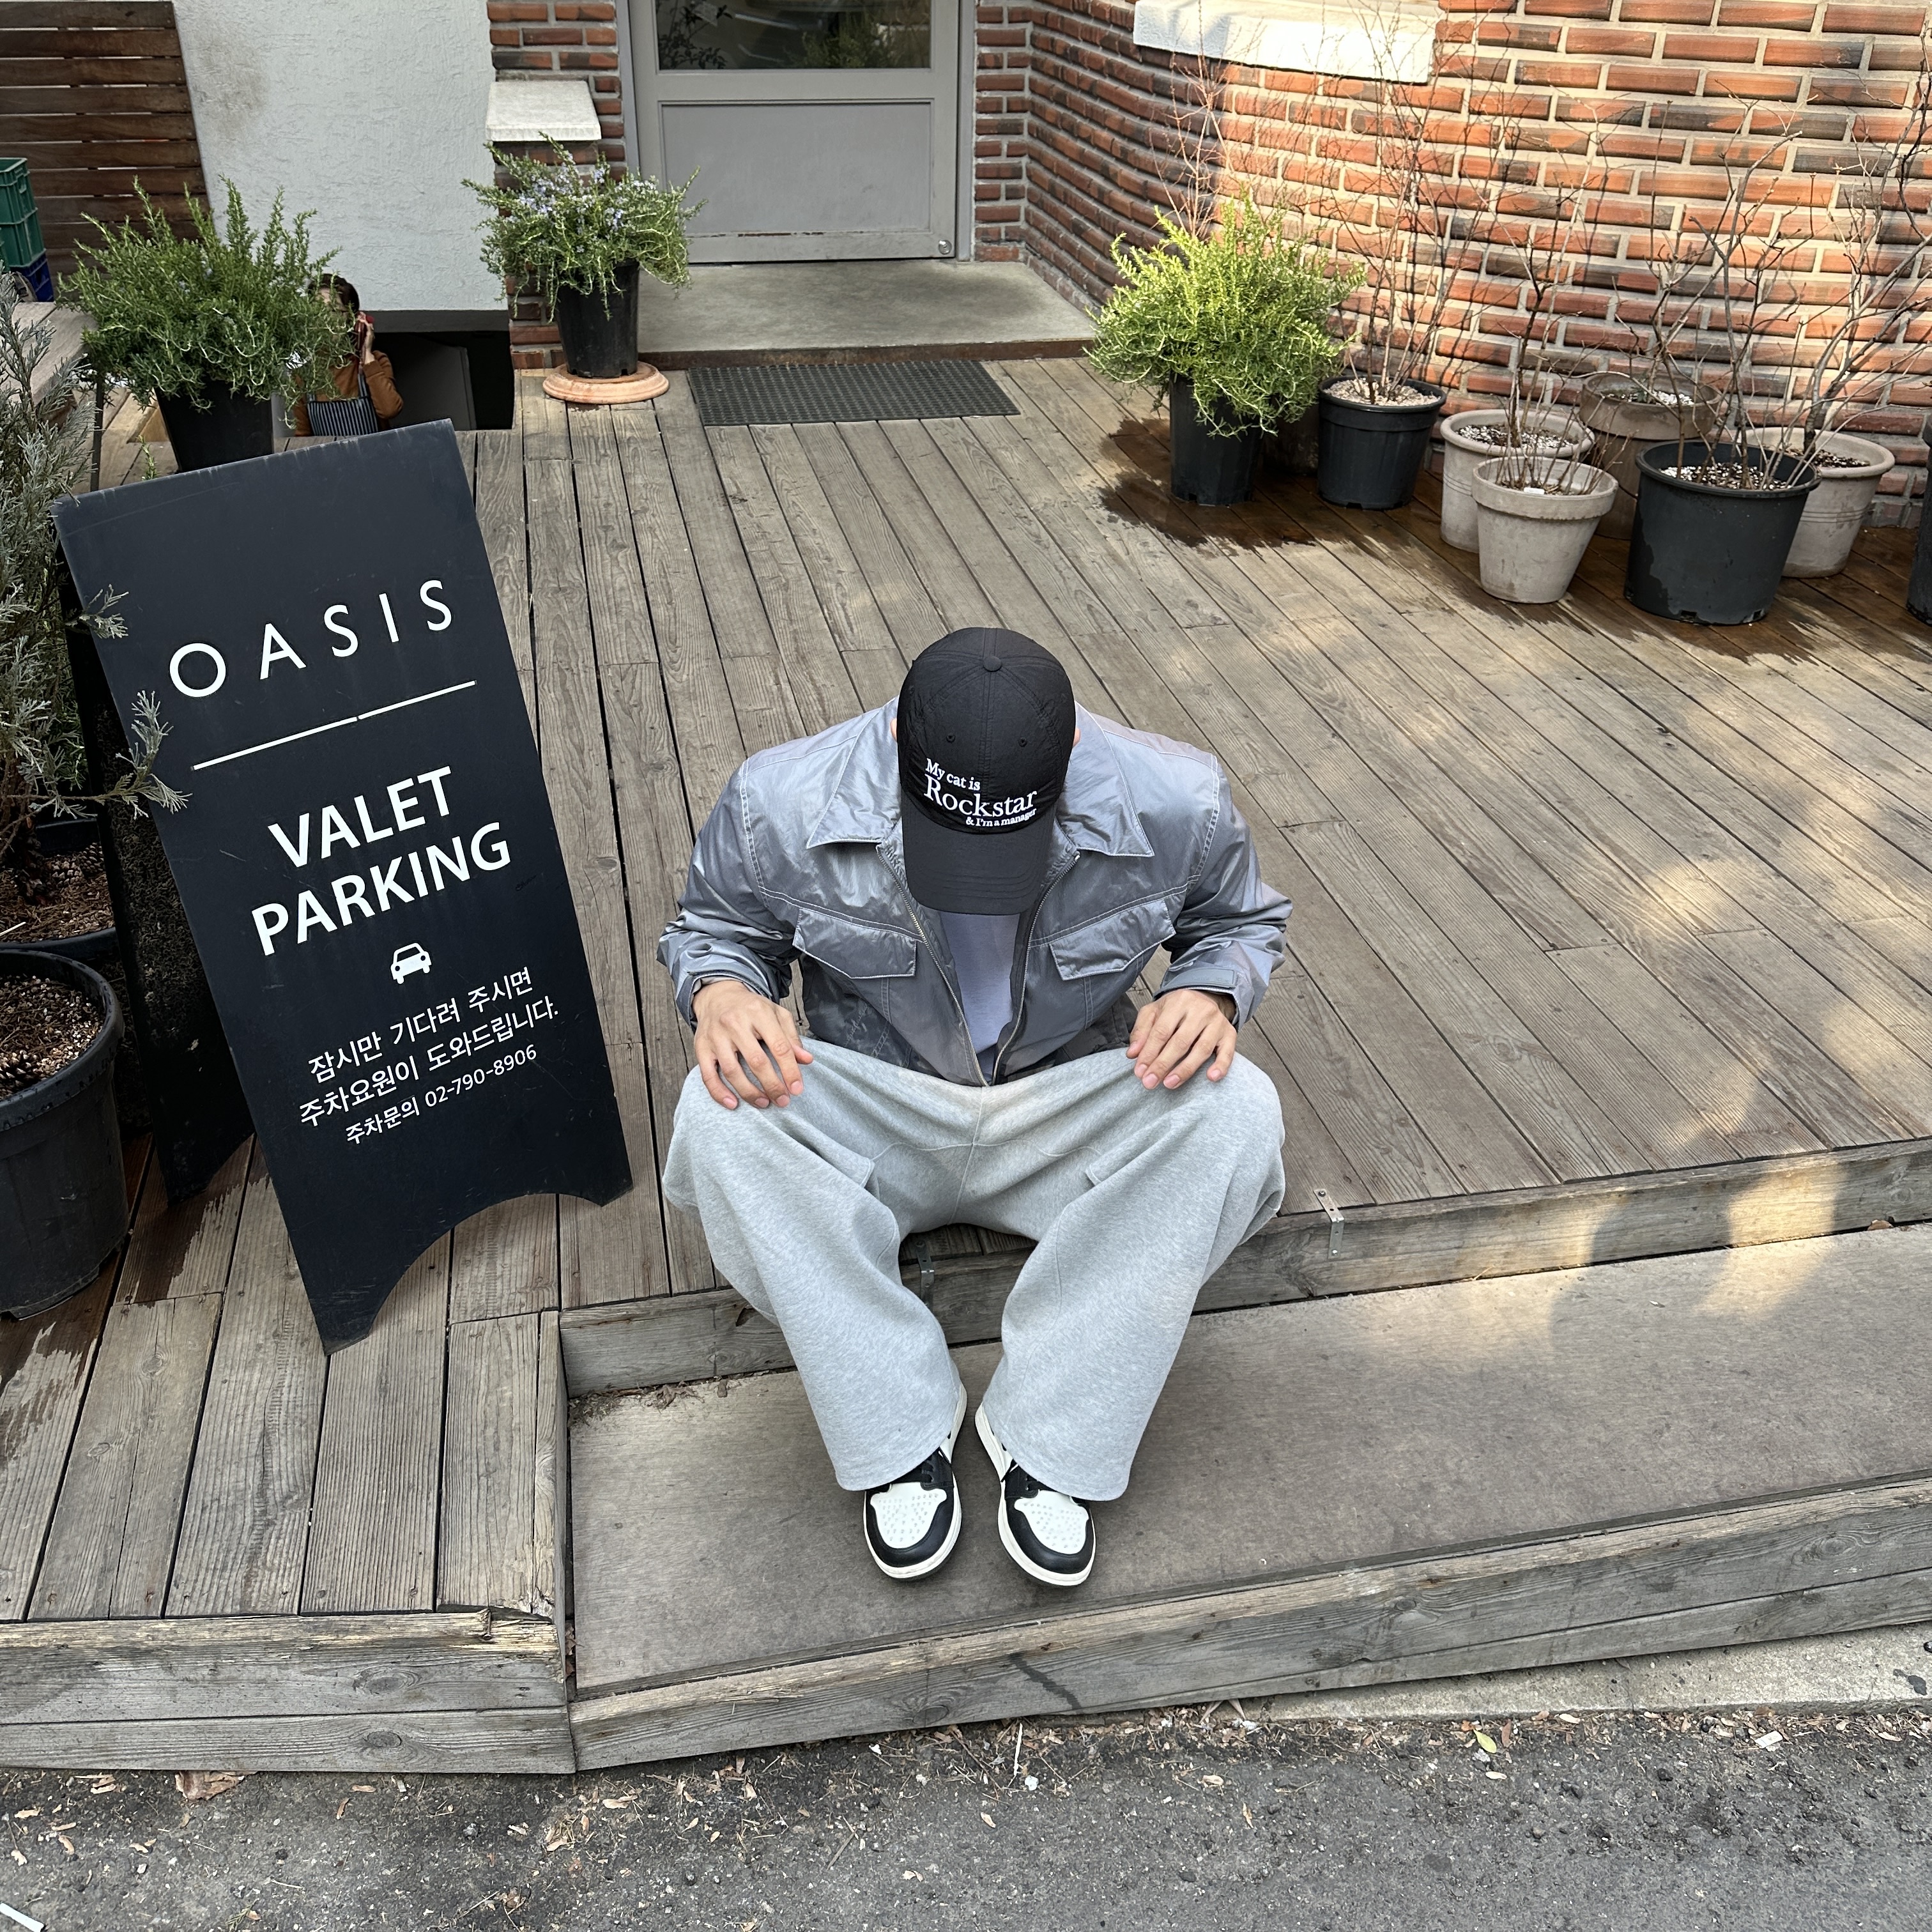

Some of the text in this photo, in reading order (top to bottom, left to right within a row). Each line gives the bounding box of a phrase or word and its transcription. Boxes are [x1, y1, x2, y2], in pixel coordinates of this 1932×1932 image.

[170, 579, 452, 697] OASIS
[268, 766, 452, 867] VALET
[924, 773, 1037, 817] Rockstar
[925, 758, 981, 791] My cat is
[965, 816, 975, 826] &
[976, 818, 993, 827] I'm
[1000, 808, 1037, 825] manager
[252, 822, 511, 955] PARKING
[299, 995, 558, 1127] 주차요원이 도와드립니다.
[308, 966, 533, 1084] 잠시만 기다려 주시면
[345, 1045, 537, 1144] 주차문의 02-790-8906
